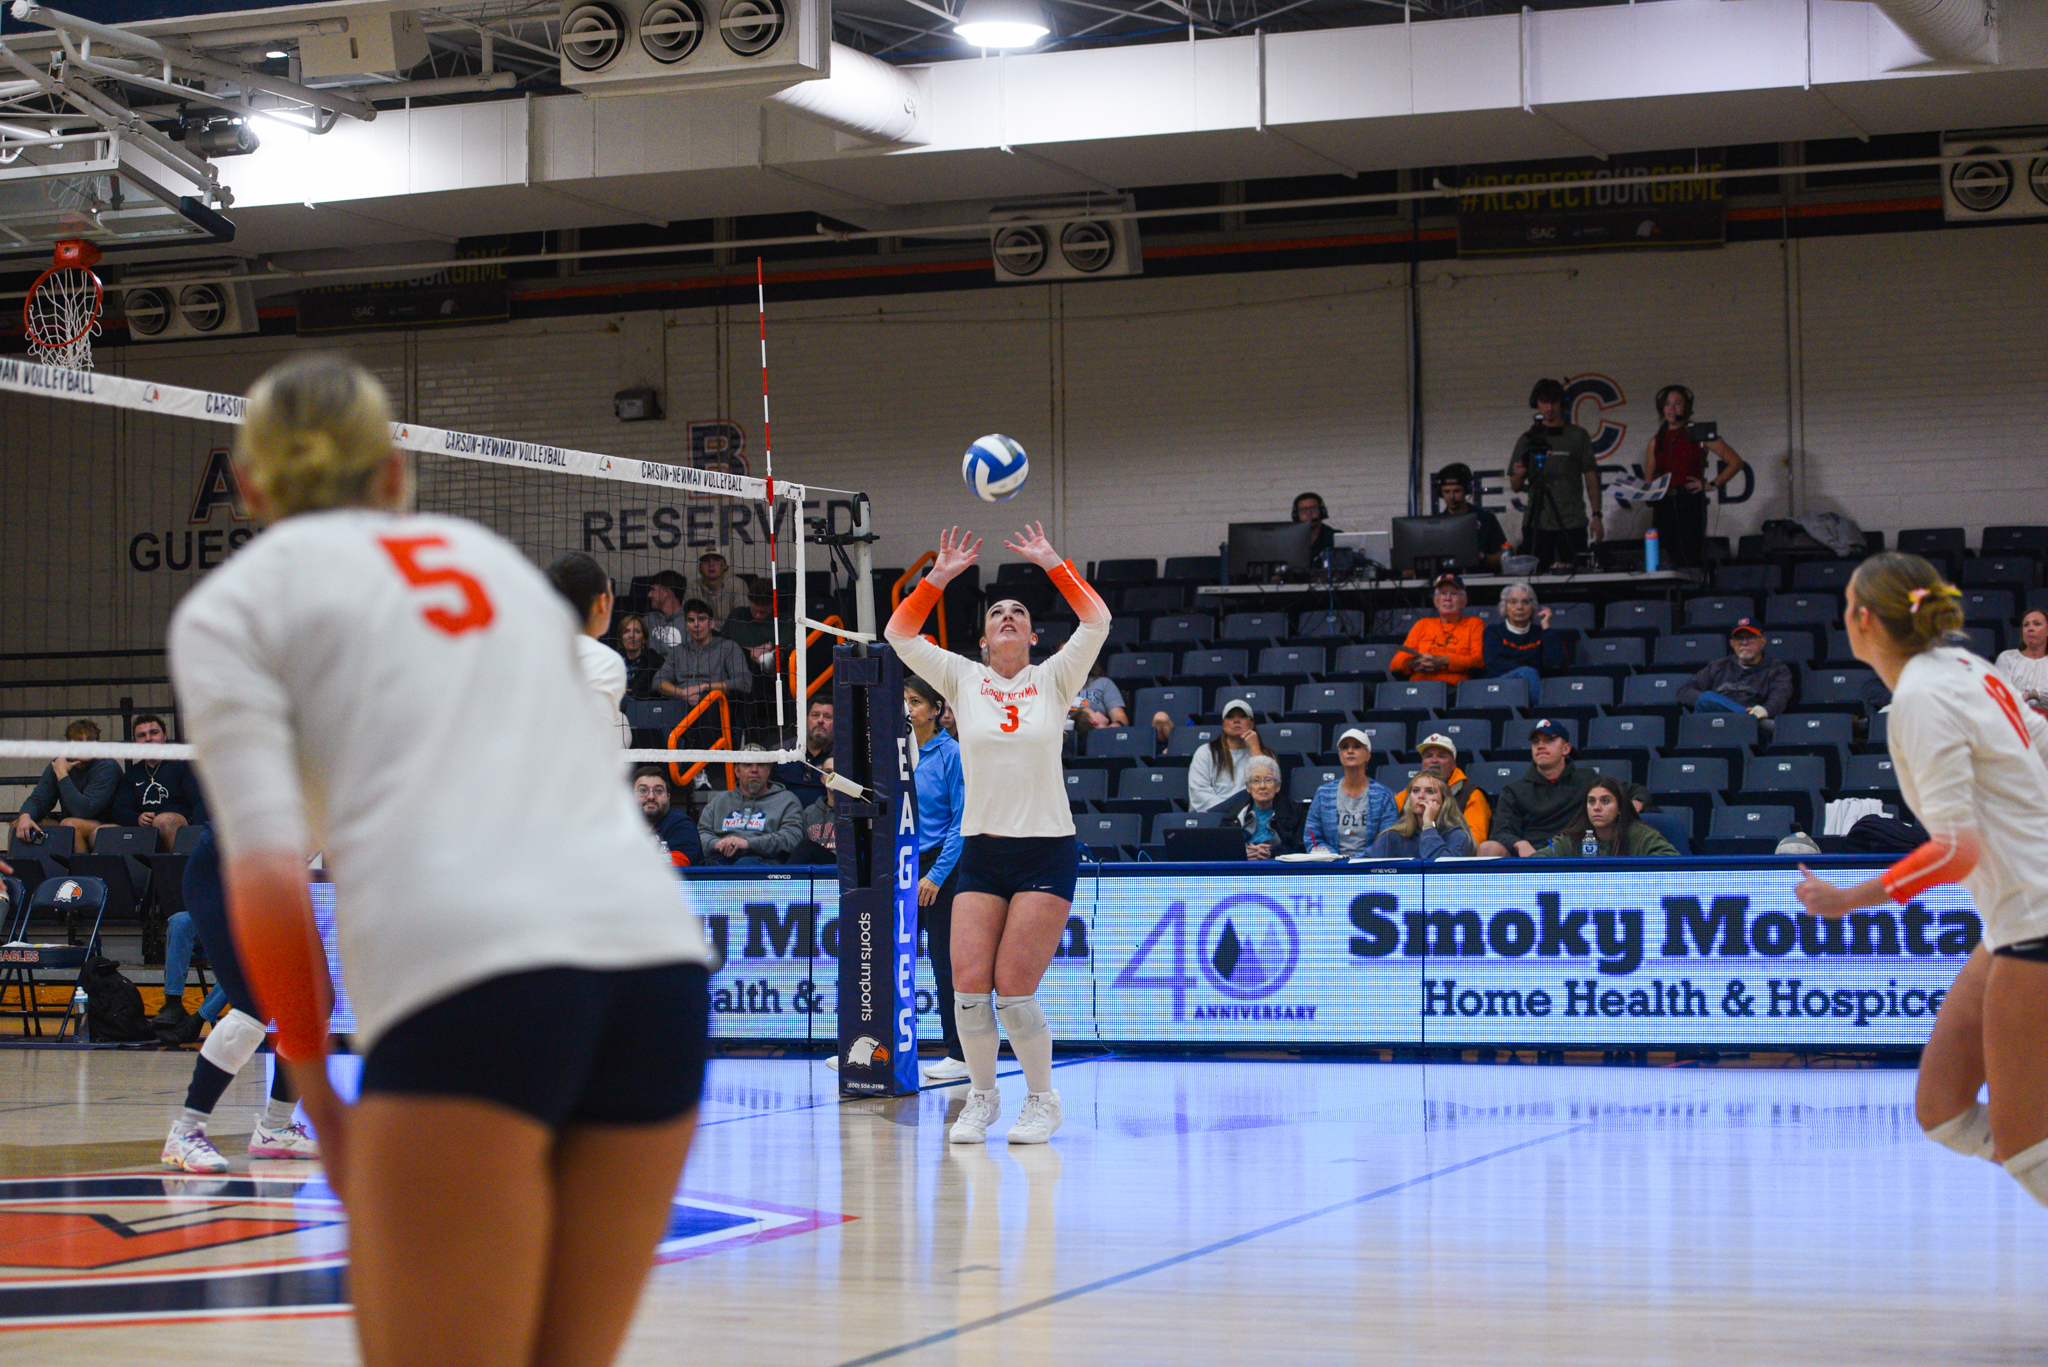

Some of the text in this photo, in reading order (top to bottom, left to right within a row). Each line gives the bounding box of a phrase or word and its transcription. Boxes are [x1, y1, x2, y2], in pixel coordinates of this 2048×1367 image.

[1460, 163, 1723, 212] #RESPECTOURGAME
[23, 364, 94, 395] VOLLEYBALL
[445, 431, 567, 467] CARSON-NEWMAN VOLLEYBALL
[641, 461, 743, 492] CARSON-NEWMAN VOLLEYBALL
[583, 499, 855, 551] RESERVED
[129, 527, 267, 572] GUES
[375, 533, 496, 635] 5
[1000, 704, 1019, 733] 3
[896, 737, 917, 1053] EAGLES
[1349, 891, 1985, 975] Smoky Mounta
[858, 912, 873, 1022] sports imports
[712, 978, 781, 1016] alth
[1193, 1004, 1317, 1020] ANNIVERSARY
[1423, 977, 1950, 1027] Home Health & Hospice
